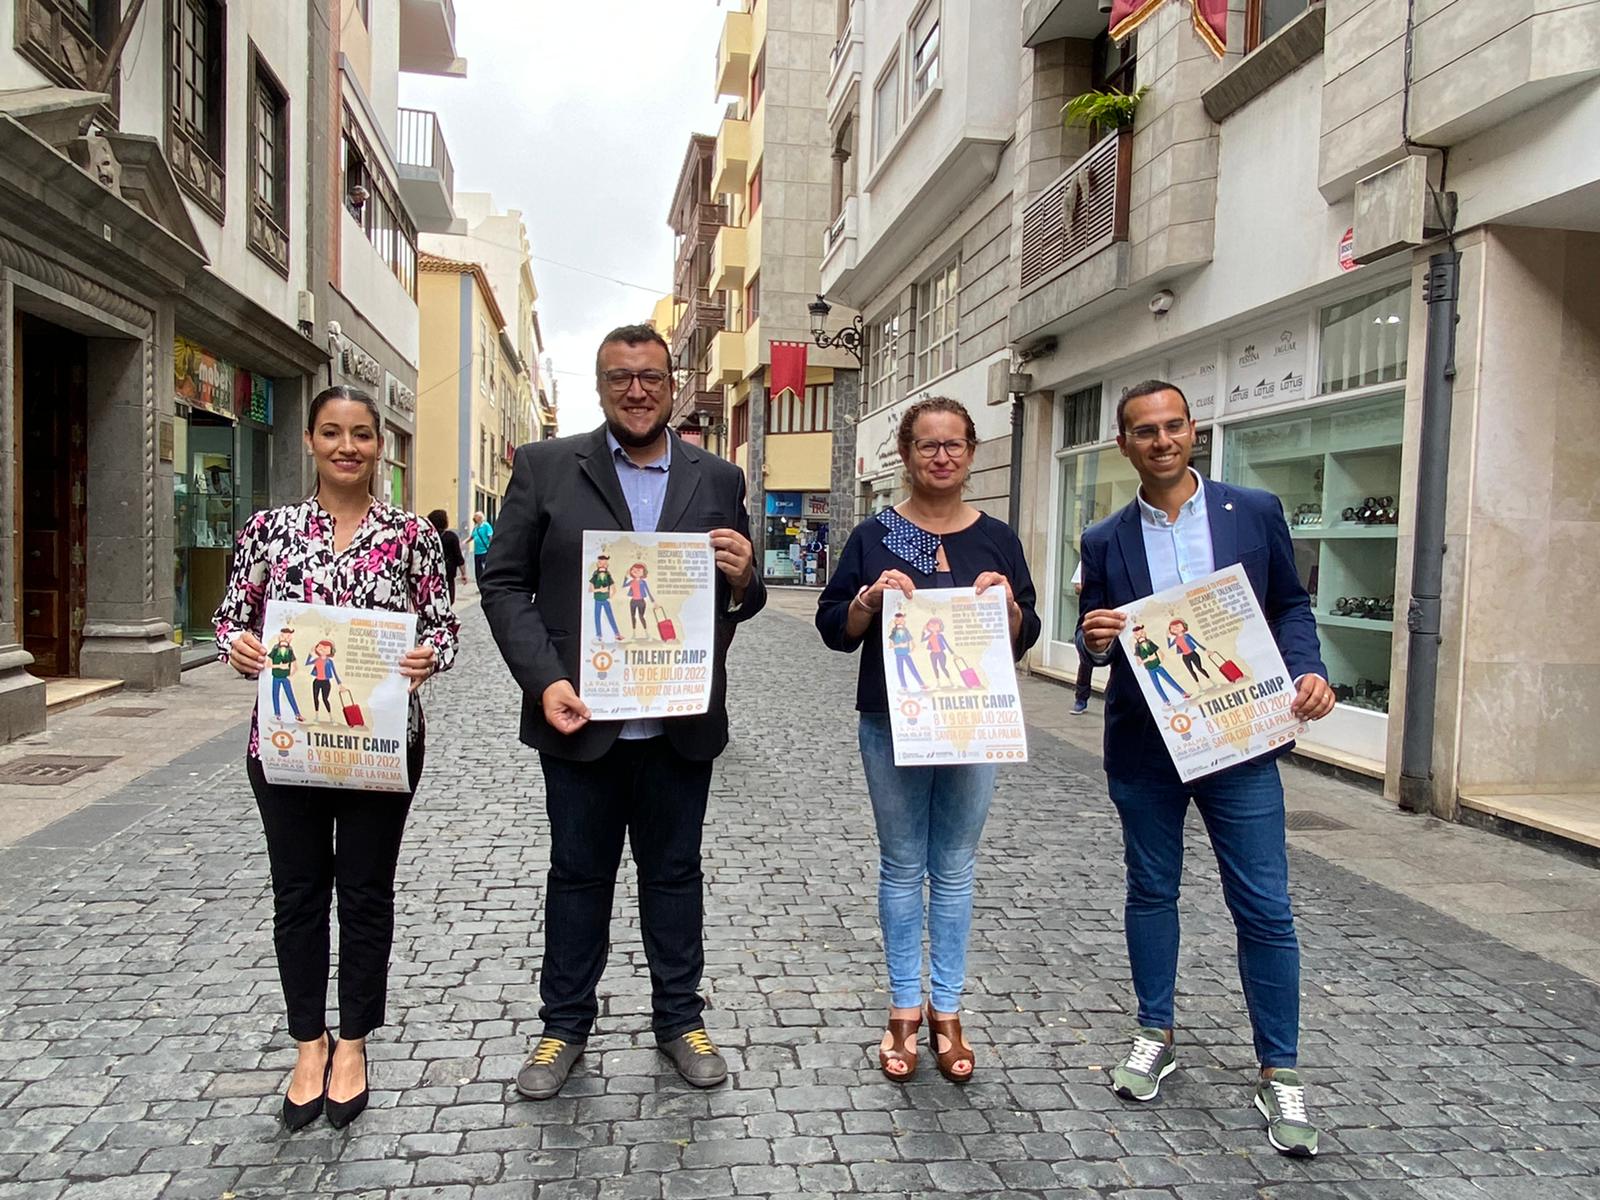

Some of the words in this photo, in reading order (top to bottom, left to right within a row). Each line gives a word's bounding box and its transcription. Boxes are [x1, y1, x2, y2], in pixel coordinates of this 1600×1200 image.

[1254, 385, 1275, 397] LOTUS
[1280, 378, 1303, 391] LOTUS
[1229, 391, 1249, 403] LOTUS
[624, 650, 628, 664] I
[631, 650, 671, 665] TALENT
[674, 650, 707, 664] CAMP
[623, 667, 629, 681] 8
[631, 667, 638, 681] Y
[639, 667, 645, 681] 9
[647, 667, 659, 681] DE
[660, 667, 682, 681] JULIO
[684, 666, 707, 680] 2022
[622, 685, 643, 697] SANTA
[644, 685, 664, 697] CRUZ
[664, 685, 672, 696] DE
[673, 685, 681, 695] LA
[683, 683, 705, 695] PALMA
[1198, 704, 1206, 718] I
[1206, 689, 1250, 715] TALENT
[1249, 676, 1284, 700] CAMP
[932, 697, 936, 710] I
[940, 695, 979, 710] TALENT
[982, 694, 1015, 708] CAMP
[934, 713, 940, 725] 8
[941, 712, 948, 725] Y
[949, 712, 954, 725] 9
[958, 712, 969, 724] DE
[971, 711, 995, 724] JULIO
[997, 710, 1019, 723] 2022
[1206, 720, 1214, 734] 8
[1213, 718, 1220, 731] Y
[1221, 715, 1229, 729] 9
[1229, 709, 1242, 726] DE
[1243, 701, 1268, 721] JULIO
[1268, 692, 1292, 712] 2022
[977, 729, 987, 740] DE
[988, 729, 998, 739] LA
[999, 728, 1021, 739] PALMA
[1212, 732, 1236, 748] SANTA
[1236, 725, 1255, 739] CRUZ
[1254, 722, 1264, 734] DE
[1265, 718, 1275, 730] LA
[306, 731, 312, 746] I
[314, 732, 359, 750] TALENT
[362, 736, 400, 753] CAMP
[307, 749, 314, 760] 8
[316, 750, 323, 761] Y
[325, 750, 331, 762] 9
[333, 751, 345, 763] DE
[348, 752, 375, 766] JULIO
[376, 755, 401, 768] 2022
[308, 764, 332, 775] SANTA
[332, 766, 353, 777] CRUZ
[354, 768, 364, 778] DE
[366, 768, 376, 779] LA
[377, 769, 403, 781] PALMA
